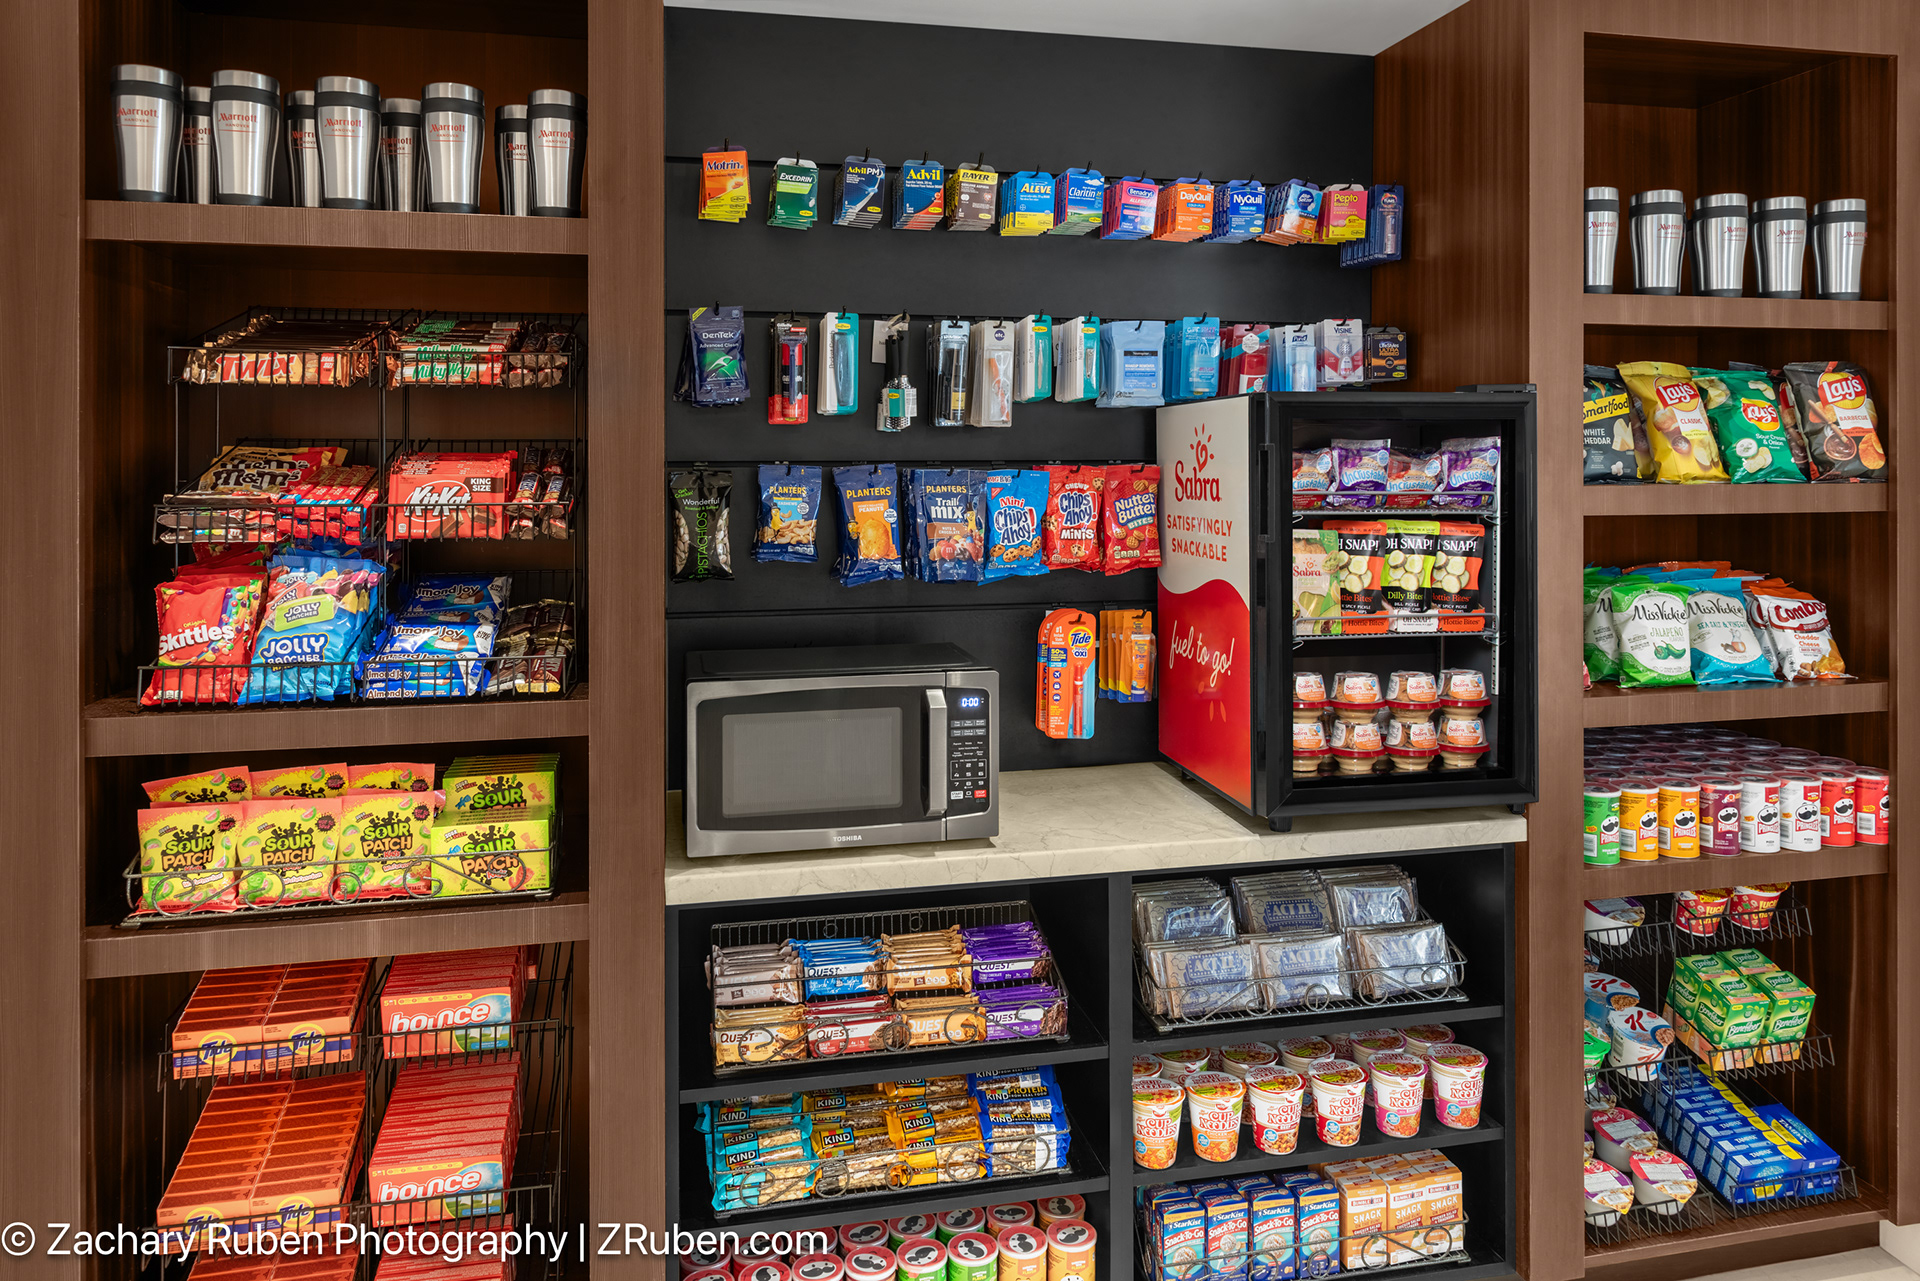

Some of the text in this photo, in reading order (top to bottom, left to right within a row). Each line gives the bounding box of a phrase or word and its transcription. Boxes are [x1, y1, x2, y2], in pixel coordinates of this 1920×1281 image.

[705, 160, 741, 172] Motrin
[846, 167, 881, 176] Advil PM
[779, 173, 813, 184] EXCEDRIN
[906, 169, 941, 181] Advil
[961, 172, 990, 182] BAYER
[1021, 183, 1052, 194] ALEVE
[1069, 187, 1096, 199] Claritin
[1180, 191, 1211, 203] DayQuil
[1233, 194, 1263, 206] NyQuil
[1334, 193, 1358, 204] Pepto
[702, 331, 734, 339] DenTek
[412, 362, 448, 380] Milky
[1658, 382, 1695, 406] Lay's
[1823, 377, 1863, 404] Lay's
[1175, 460, 1221, 502] Sabra
[770, 486, 807, 495] PLANTERS
[847, 487, 892, 499] PLANTERS
[926, 486, 967, 494] PLANTERS
[682, 498, 720, 506] Wonderful
[935, 498, 959, 506] Trail
[1000, 496, 1025, 509] Mini
[1059, 492, 1091, 514] Chips
[1115, 493, 1155, 510] Nutter
[930, 505, 964, 519] mix
[1118, 503, 1156, 525] Butter
[994, 508, 1029, 531] Chips
[1166, 514, 1233, 537] SATISFYINGLY
[697, 511, 709, 574] PISTACHIOS
[1344, 539, 1379, 551] SNAP!
[1401, 538, 1432, 551] SNAP!
[1443, 540, 1477, 552] SNAP!
[1171, 537, 1227, 562] SNACKABLE
[1293, 565, 1321, 578] Sabra
[1388, 591, 1405, 601] Dilly
[284, 601, 321, 618] JOLLY
[1071, 631, 1092, 647] Tide
[1169, 620, 1195, 670] fuel
[263, 635, 325, 658] JOLLY
[962, 698, 979, 707] 0:00
[473, 788, 522, 809] SOUR
[364, 822, 410, 840] SOUR
[265, 833, 313, 852] SOUR
[833, 834, 863, 842] TOSHIBA
[166, 836, 214, 855] SOUR
[362, 836, 413, 855] PATCH
[162, 848, 214, 871] PATCH
[263, 848, 314, 866] PATCH
[1272, 902, 1296, 915] ACT
[1196, 957, 1217, 971] ACT
[808, 968, 840, 978] QUEST
[391, 1004, 490, 1035] bounce
[1773, 1014, 1807, 1032] Benefiber
[1727, 1021, 1761, 1038] Benefiber
[720, 1033, 755, 1044] QUEST
[817, 1097, 844, 1108] KIND
[986, 1093, 1009, 1101] KIND
[721, 1110, 748, 1121] KIND
[990, 1115, 1013, 1123] KIND
[1209, 1110, 1234, 1122] CUP
[905, 1117, 932, 1129] KIND
[1145, 1117, 1172, 1129] CUP
[1199, 1117, 1239, 1131] NOODLES
[726, 1132, 754, 1142] KIND
[1136, 1123, 1178, 1138] NOODLES
[824, 1132, 852, 1145] KIND
[729, 1150, 757, 1163] KIND
[380, 1171, 482, 1206] bounce
[1307, 1201, 1336, 1211] StarKist
[1431, 1195, 1458, 1211] SNACK
[1217, 1211, 1245, 1222] StarKist
[1261, 1207, 1290, 1216] StarKist
[1353, 1209, 1382, 1224] SNACK
[1395, 1203, 1422, 1219] SNACK
[1172, 1218, 1202, 1229] StarKist
